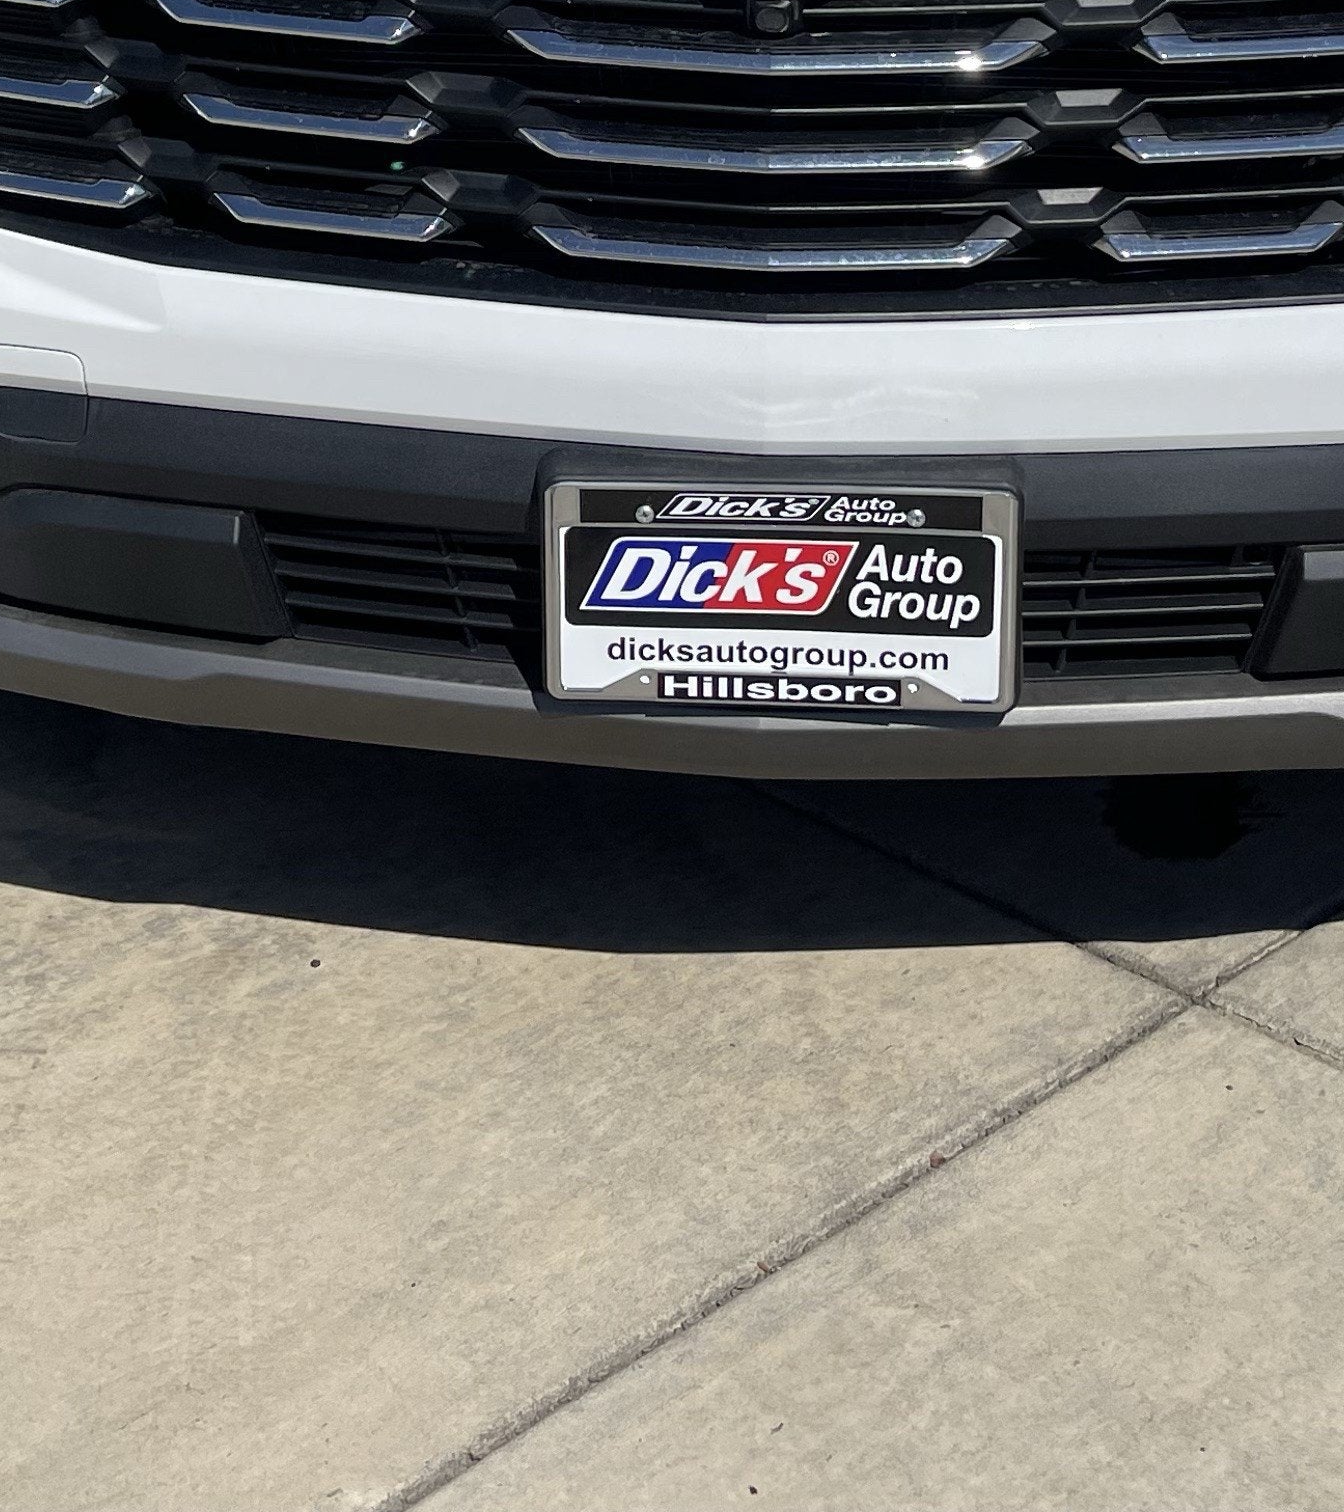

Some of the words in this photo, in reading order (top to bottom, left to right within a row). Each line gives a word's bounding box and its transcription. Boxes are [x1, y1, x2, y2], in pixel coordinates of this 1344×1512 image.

[823, 509, 907, 526] Group
[830, 495, 896, 511] Auto
[855, 544, 964, 584] Auto
[848, 582, 981, 629] Group
[606, 636, 950, 672] dicksautogroup.com
[663, 673, 898, 704] Hillsboro
